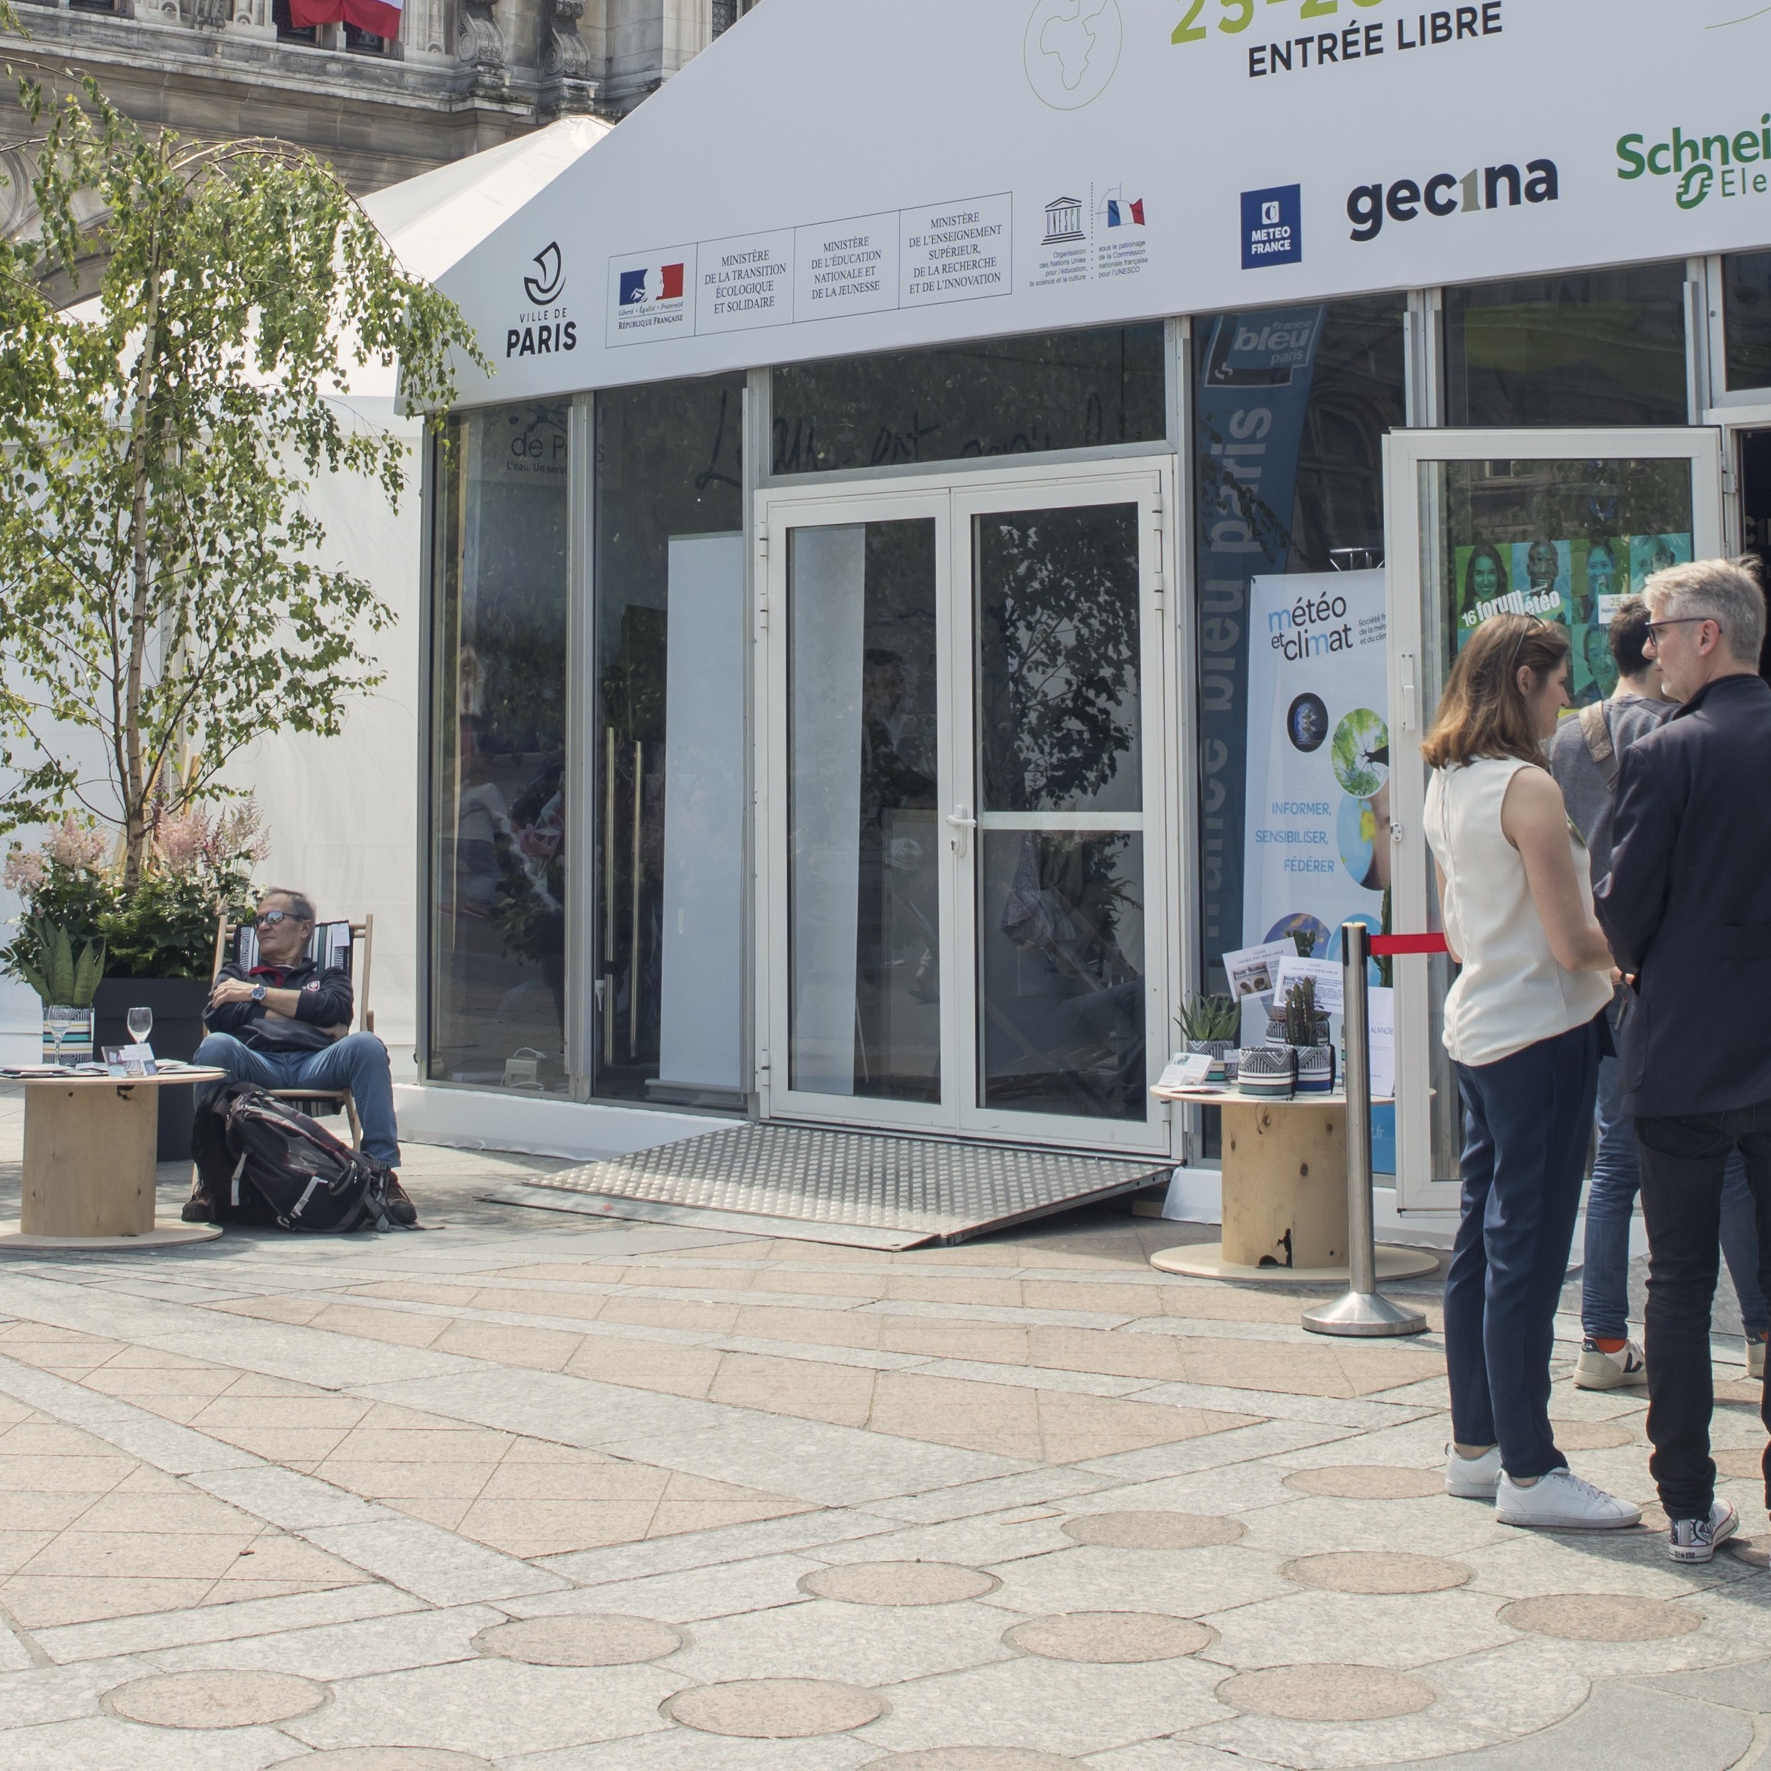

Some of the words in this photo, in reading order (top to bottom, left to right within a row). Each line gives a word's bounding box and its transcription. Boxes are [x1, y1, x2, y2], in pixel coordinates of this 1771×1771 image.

[1248, 20, 1384, 78] ENTRÉE
[1398, 1, 1503, 50] LIBRE
[930, 211, 980, 229] MINISTÈRE
[909, 236, 921, 248] DE
[924, 224, 1003, 246] L'ENSEIGNEMENT
[1251, 226, 1291, 242] METEO
[823, 236, 870, 253] MINISTÈRE
[1251, 240, 1291, 255] FRANCE
[721, 249, 770, 267] MINISTÈRE
[811, 259, 823, 270] DE
[824, 249, 882, 268] L'ÉDUCATION
[914, 267, 926, 278] DE
[928, 265, 940, 276] LA
[941, 256, 997, 275] RECHERCHE
[704, 274, 717, 285] DE
[718, 272, 731, 283] LA
[732, 263, 786, 281] TRANSITION
[814, 267, 863, 285] NATIONALE
[865, 265, 876, 276] ET
[909, 283, 921, 295] ET
[922, 281, 935, 293] DE
[937, 271, 1002, 291] L'INNOVATION
[716, 280, 774, 299] ÉCOLOGIQUE
[811, 288, 824, 300] DE
[825, 287, 837, 298] LA
[838, 280, 881, 297] JEUNESSE
[714, 303, 725, 314] ET
[727, 295, 775, 312] SOLIDAIRE
[520, 310, 548, 323] VILLE
[554, 308, 567, 319] DE
[1272, 320, 1313, 331] france
[506, 321, 577, 358] PARIS
[1234, 326, 1311, 351] bleu
[1271, 348, 1304, 366] paris
[1268, 591, 1347, 632] météo
[1271, 632, 1284, 649] et
[1284, 623, 1354, 661] climat
[1271, 802, 1331, 816] INFORMER,
[1255, 830, 1328, 845] SENSIBILISER,
[1284, 855, 1335, 872] FÉDÉRER
